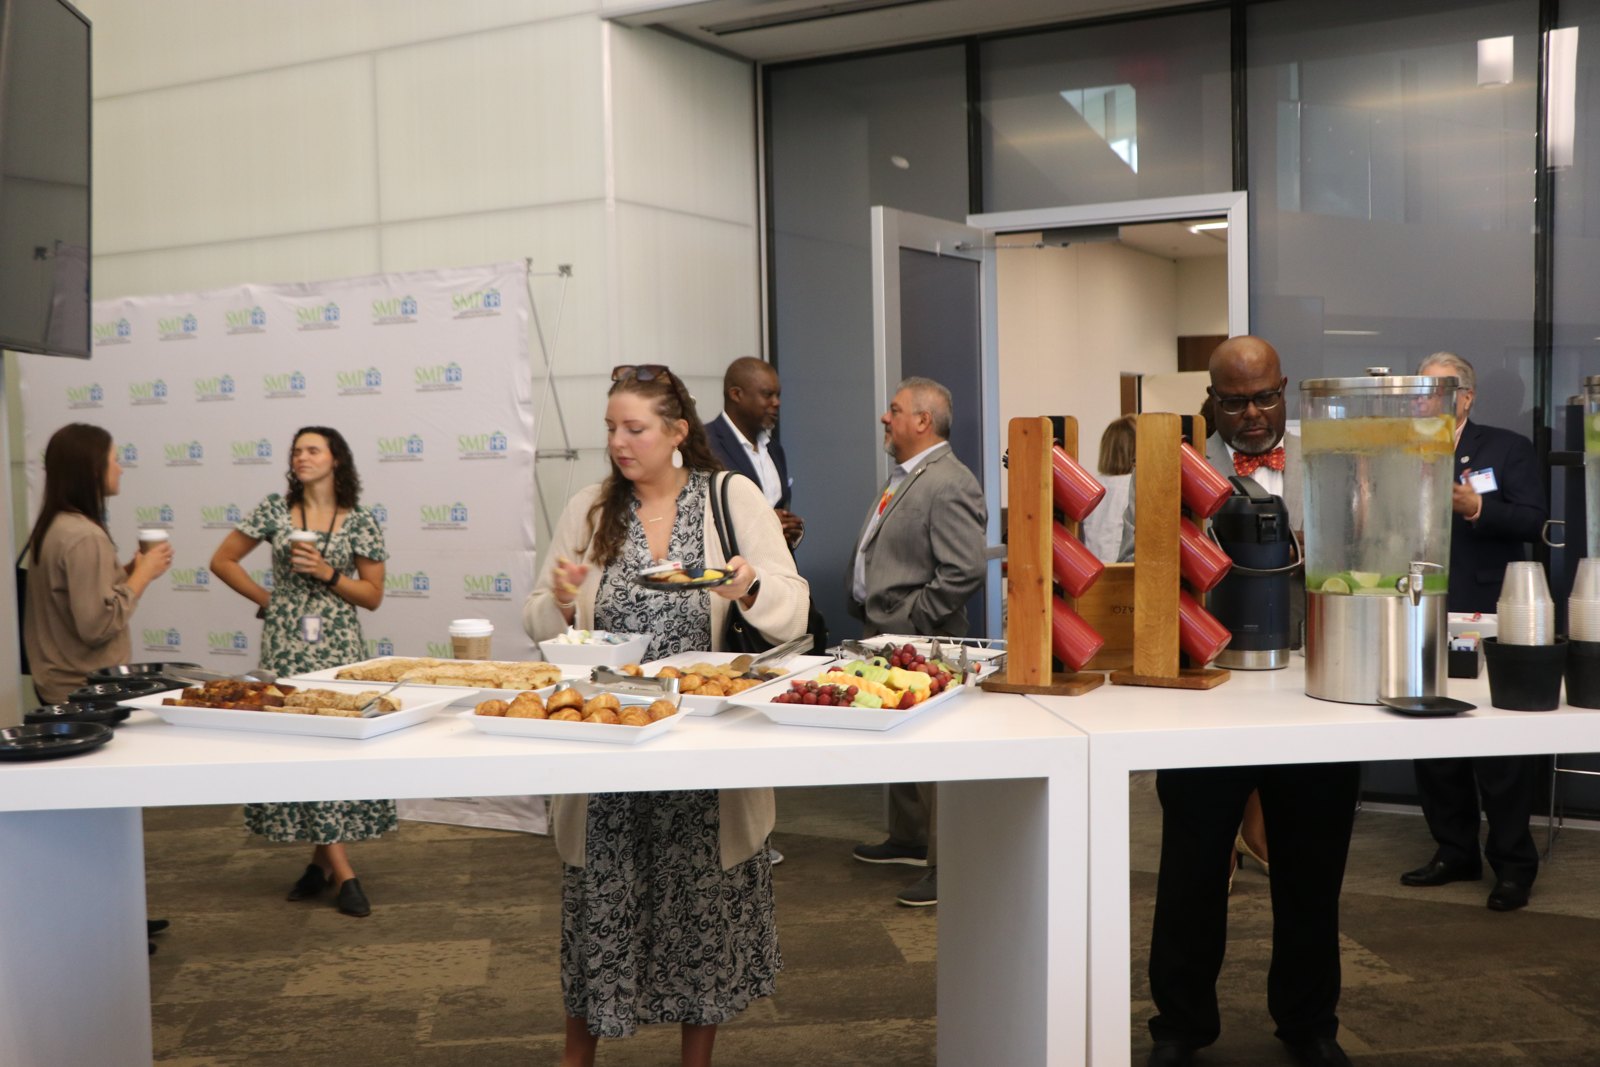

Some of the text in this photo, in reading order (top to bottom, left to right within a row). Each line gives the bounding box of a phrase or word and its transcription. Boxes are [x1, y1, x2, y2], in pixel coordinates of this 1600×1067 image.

[459, 434, 489, 451] SMP
[421, 505, 451, 521] SMP
[465, 575, 512, 592] SMP HR
